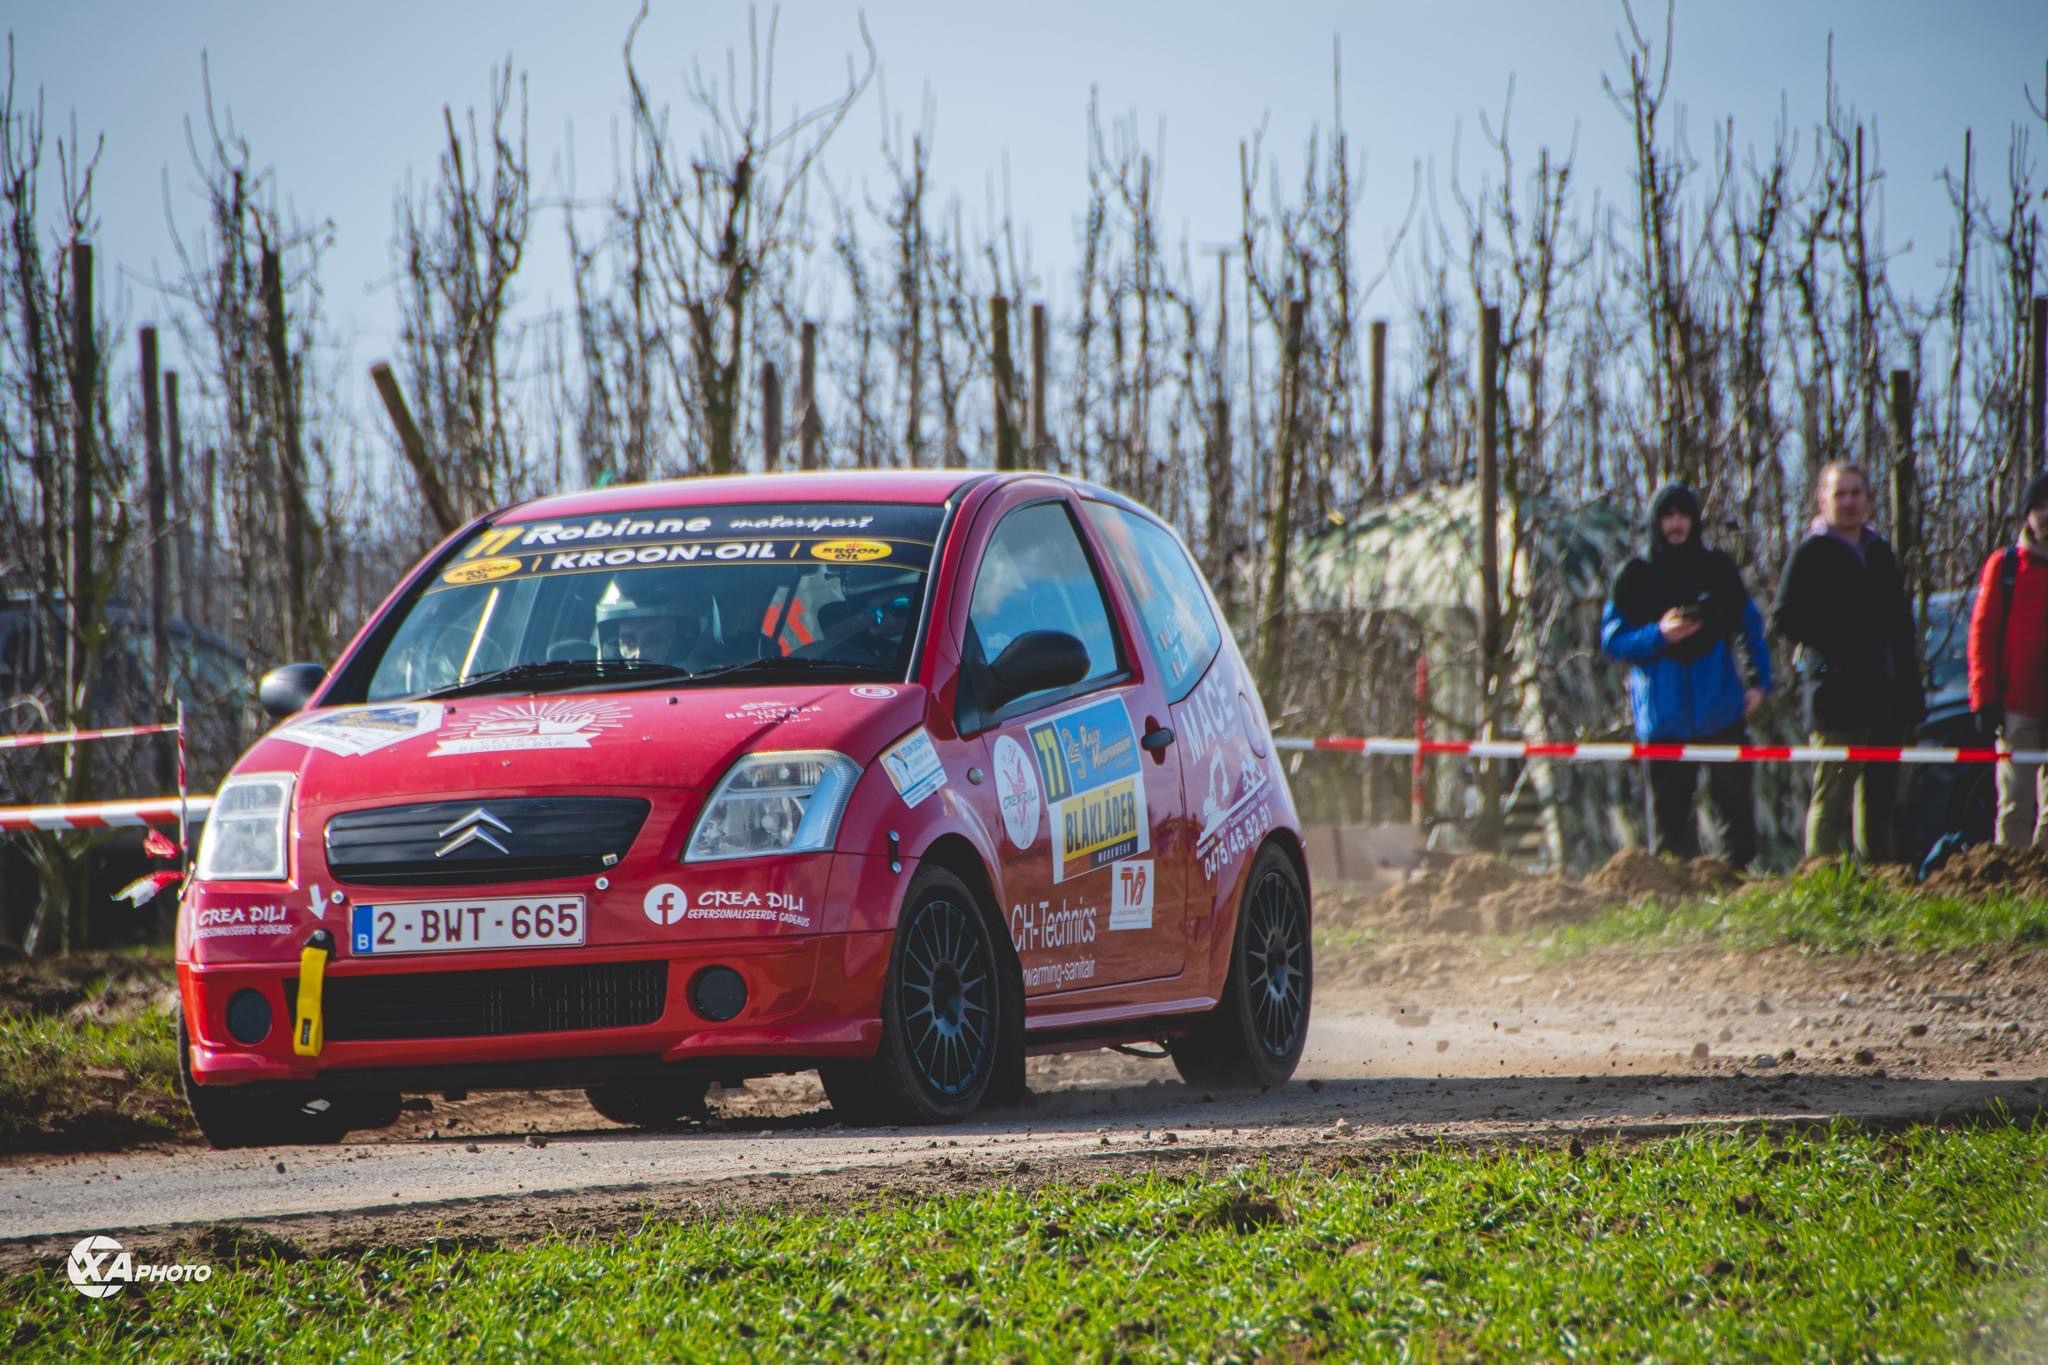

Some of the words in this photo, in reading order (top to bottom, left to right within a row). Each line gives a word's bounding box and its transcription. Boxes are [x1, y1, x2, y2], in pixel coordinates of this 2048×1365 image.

[522, 517, 712, 545] Robinne
[729, 514, 874, 532] motorsport
[551, 542, 776, 570] KROON-OIL
[1034, 727, 1066, 799] 77
[1064, 790, 1137, 855] BLÅKLÄDER
[687, 908, 778, 921] GEPERSONALISEERDE
[697, 890, 763, 908] CREA
[766, 892, 804, 912] DILI
[199, 907, 246, 926] CREA
[249, 905, 286, 923] DILI
[1011, 896, 1097, 953] CH-Technics
[357, 933, 370, 950] B
